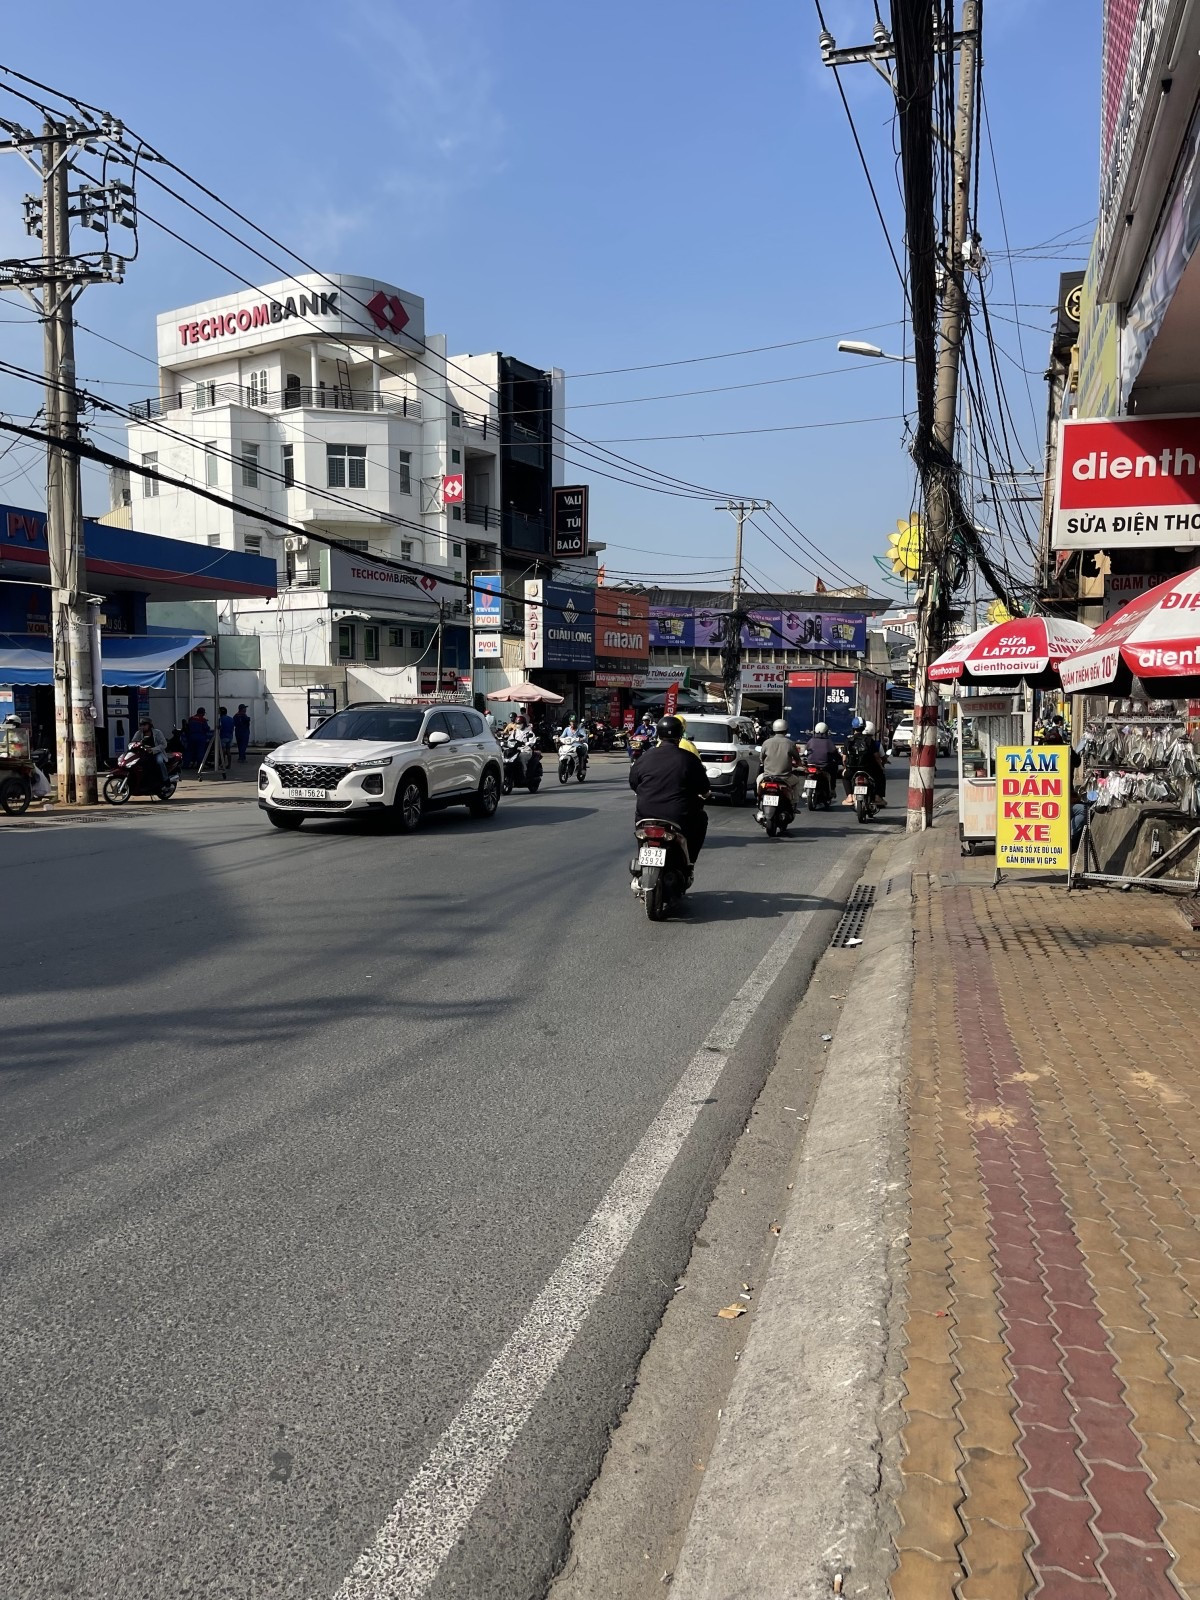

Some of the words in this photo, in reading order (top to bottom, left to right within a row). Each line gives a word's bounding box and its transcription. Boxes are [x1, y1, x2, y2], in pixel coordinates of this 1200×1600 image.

[178, 292, 341, 346] TECHCOMBANK
[1072, 447, 1200, 481] dienth
[563, 495, 581, 505] VALI
[566, 515, 581, 528] TÚI
[1067, 513, 1107, 534] SỬA
[1112, 512, 1159, 536] ĐIỆN
[557, 536, 581, 550] BALÔ
[982, 645, 1036, 657] LAPTOP
[973, 660, 1039, 672] dienthoaivui
[1002, 775, 1062, 797] DÁN
[1004, 801, 1060, 820] KEO
[1013, 824, 1051, 843] XE
[1034, 846, 1041, 854] XE
[1044, 857, 1057, 865] GPS
